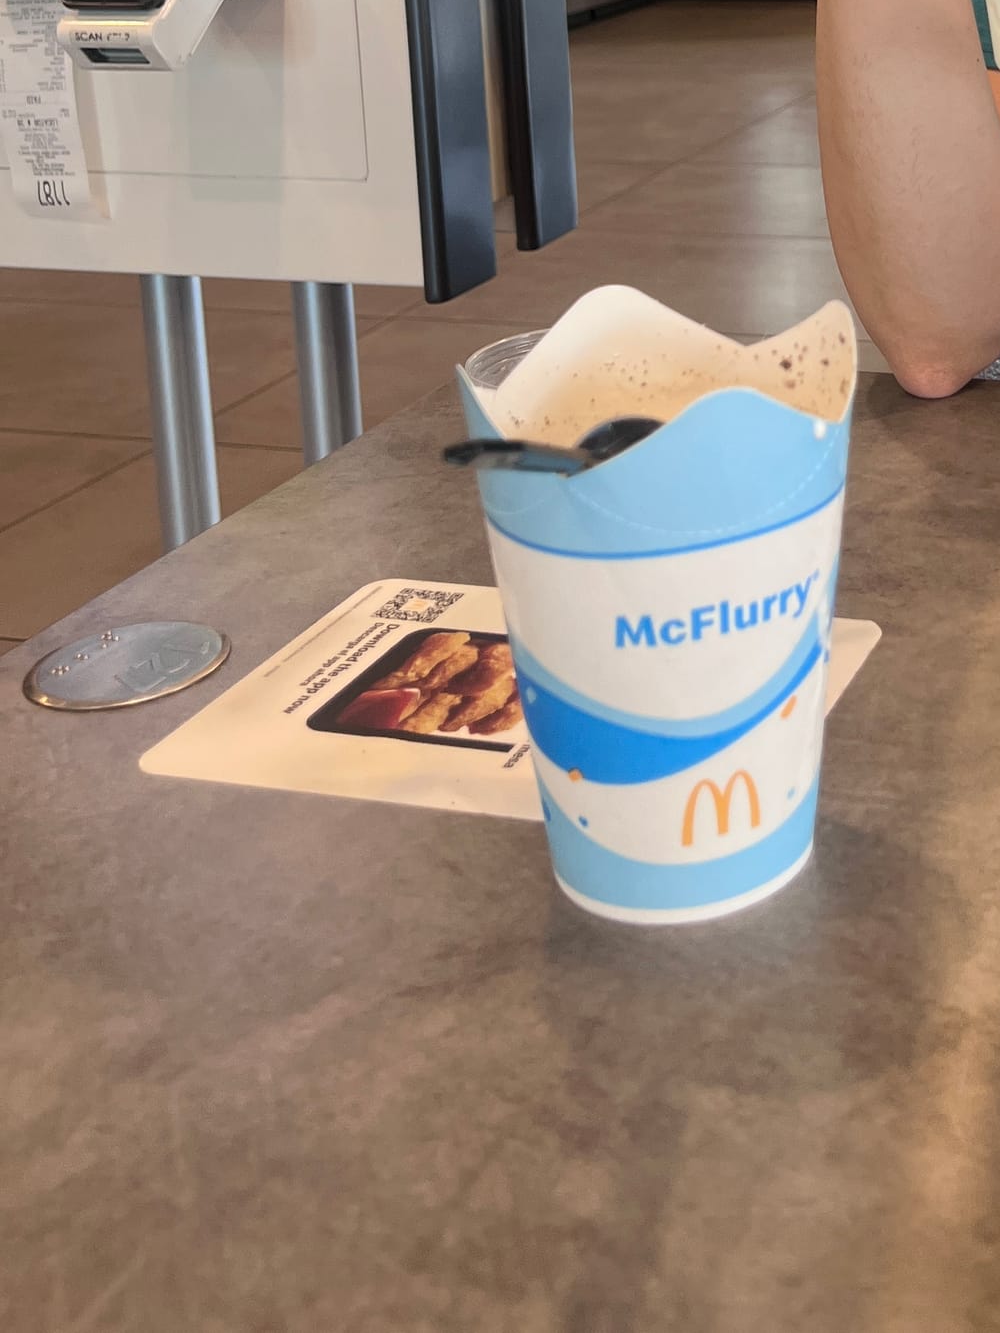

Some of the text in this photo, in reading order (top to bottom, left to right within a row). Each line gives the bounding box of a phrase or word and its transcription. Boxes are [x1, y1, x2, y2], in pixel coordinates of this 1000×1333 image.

[75, 32, 103, 42] SCAN
[37, 179, 71, 207] 1187
[614, 575, 812, 650] McFlurry
[349, 623, 401, 663] Download
[328, 663, 351, 677] the
[308, 677, 331, 694] app
[284, 695, 309, 714] now
